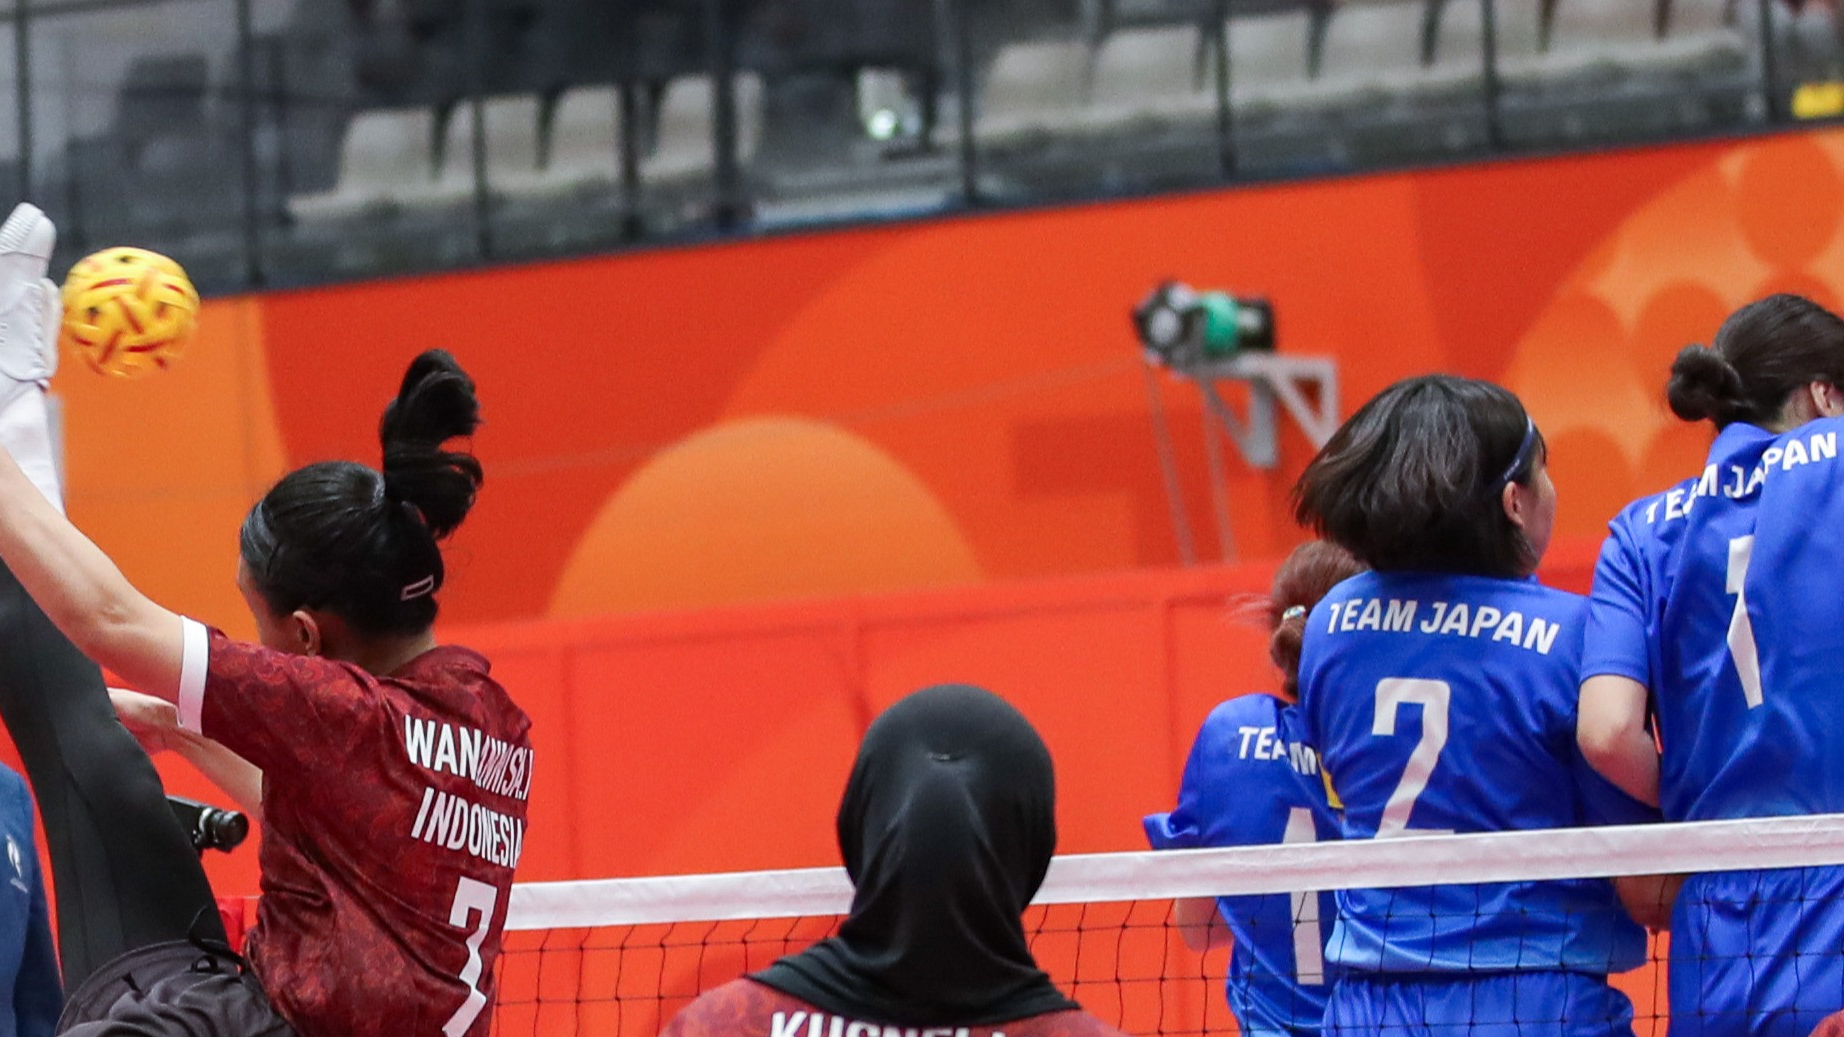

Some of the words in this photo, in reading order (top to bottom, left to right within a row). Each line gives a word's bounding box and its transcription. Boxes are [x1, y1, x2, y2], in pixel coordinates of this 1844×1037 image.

[1723, 432, 1838, 499] JAPAN
[1327, 598, 1418, 634] TEAM
[1419, 602, 1560, 655] JAPAN
[1371, 677, 1456, 841] 2
[411, 786, 523, 869] INDONESIA
